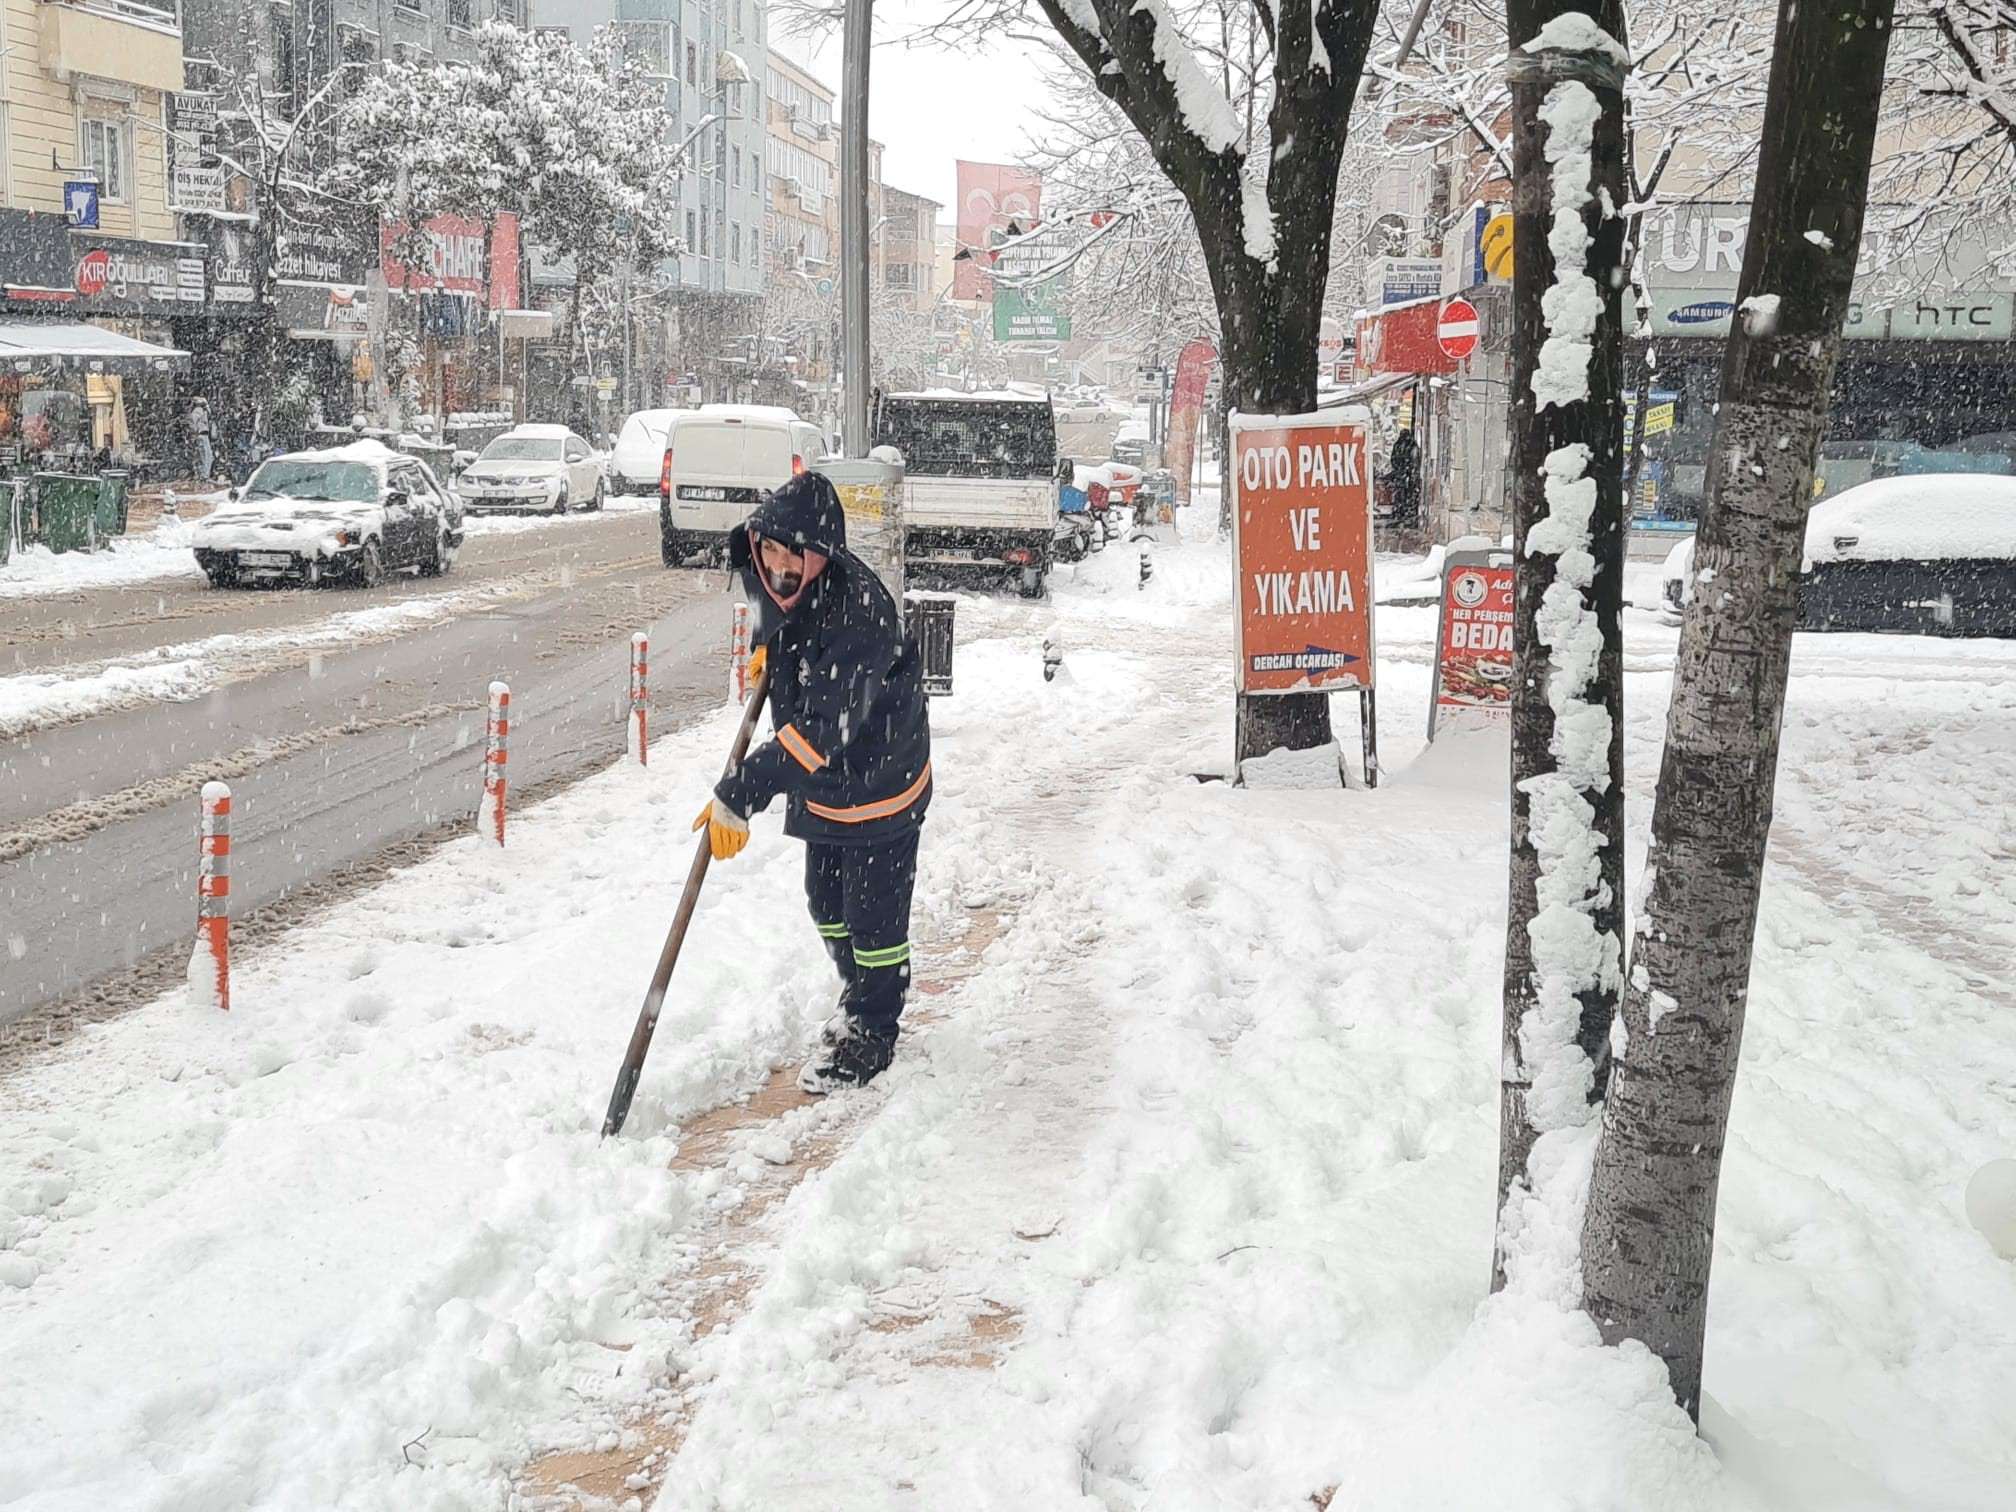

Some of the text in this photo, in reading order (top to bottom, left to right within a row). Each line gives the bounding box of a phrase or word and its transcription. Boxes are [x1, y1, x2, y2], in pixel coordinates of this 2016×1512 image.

[177, 97, 216, 110] AVUKAT
[1243, 442, 1361, 491] OTO PARK
[1289, 507, 1322, 552] VE
[1253, 570, 1355, 616] YIKAMA
[1452, 608, 1514, 624] HER PERŞEM
[1451, 621, 1514, 651] BEDA
[1254, 652, 1345, 669] DERGAH OCAKBAŞI
